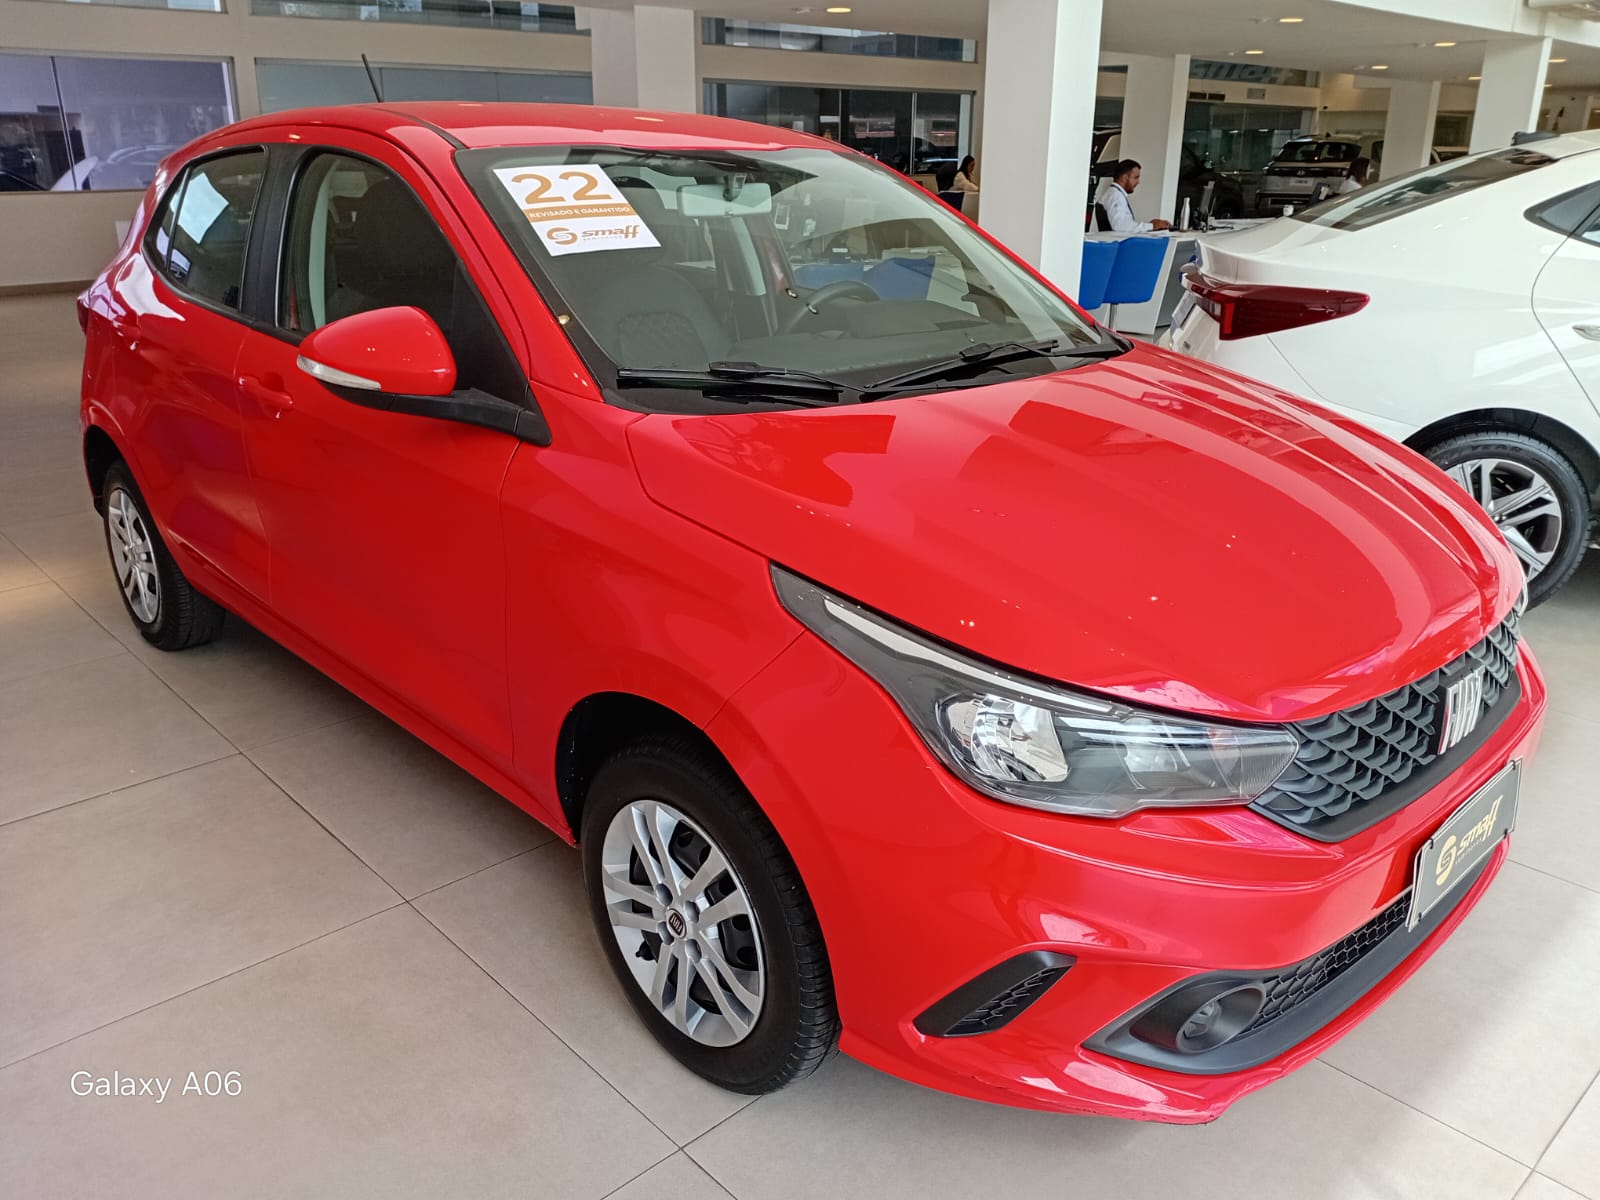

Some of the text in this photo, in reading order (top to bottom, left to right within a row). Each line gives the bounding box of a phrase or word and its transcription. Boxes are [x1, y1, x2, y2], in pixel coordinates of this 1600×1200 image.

[511, 171, 612, 204] 22
[529, 208, 573, 219] REVISADO
[581, 206, 631, 215] GARANTIDO
[581, 225, 640, 239] smaff
[1438, 664, 1486, 755] FIAT
[1457, 794, 1503, 856] smaff
